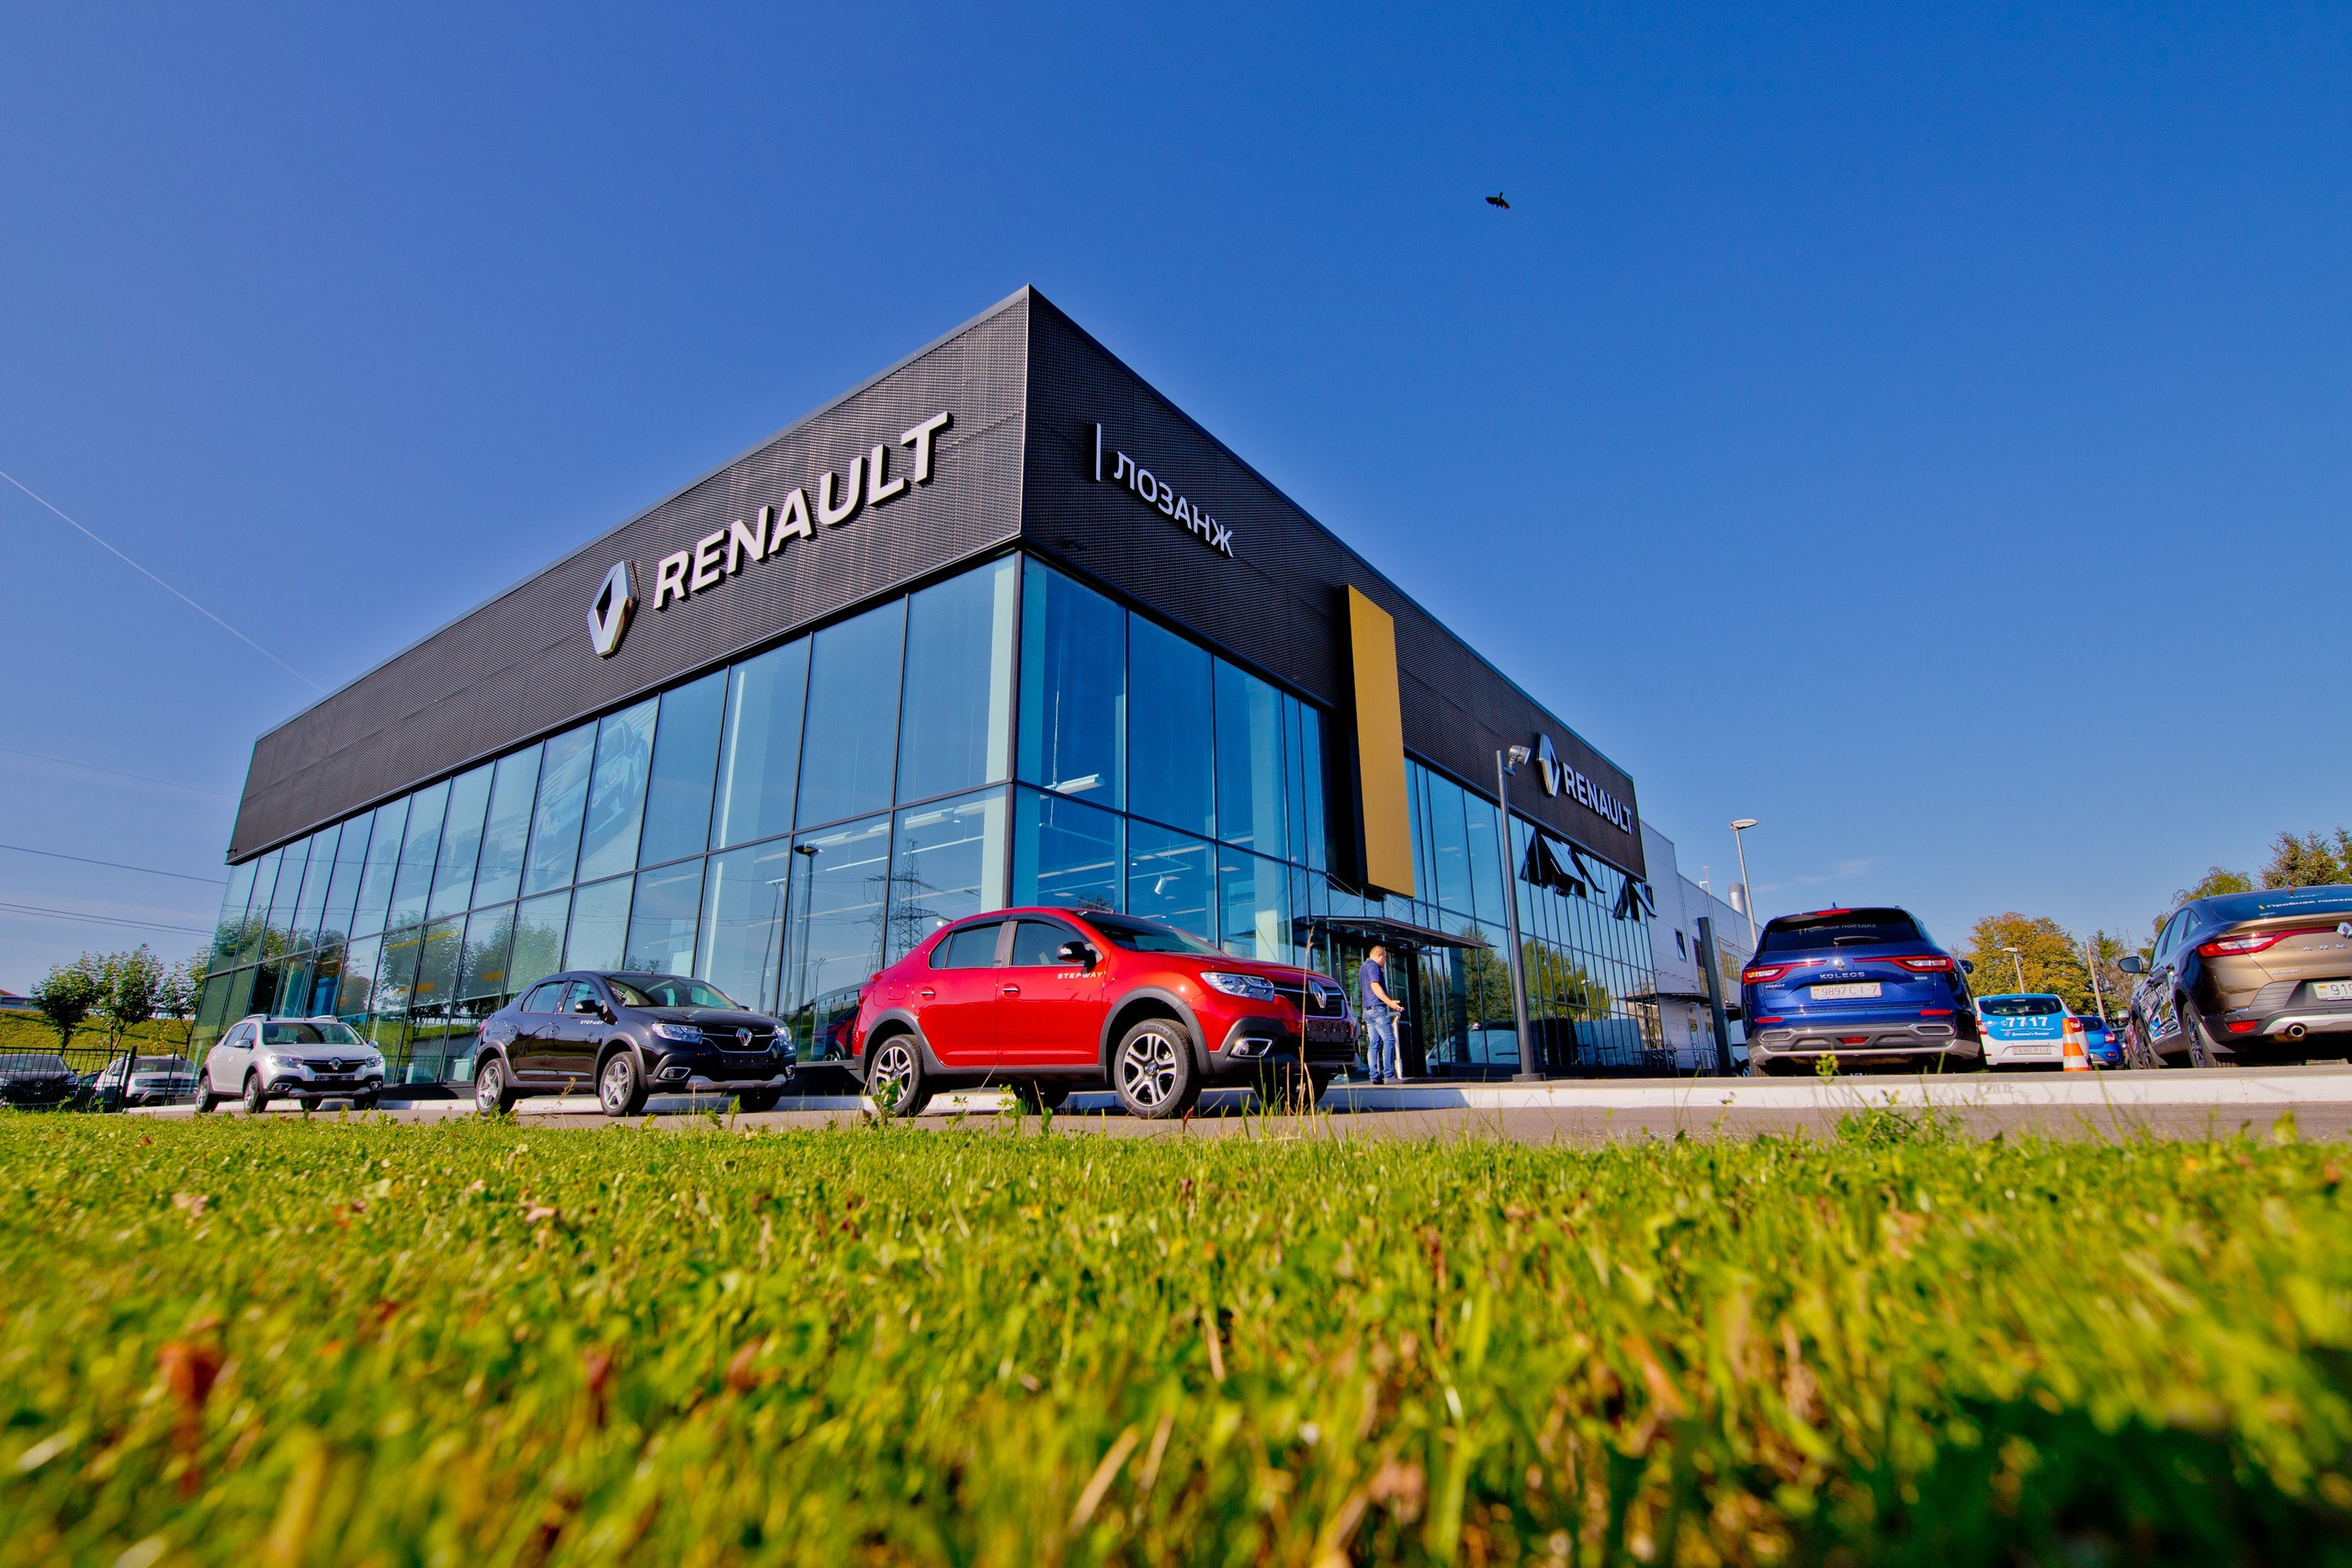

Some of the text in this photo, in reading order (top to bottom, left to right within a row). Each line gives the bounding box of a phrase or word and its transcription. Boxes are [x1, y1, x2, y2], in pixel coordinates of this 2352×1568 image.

[653, 411, 949, 610] RENAULT
[1114, 451, 1234, 558] ЛОЗАНЖ
[1563, 762, 1633, 835] RENAULT
[1057, 971, 1102, 979] STEPWAY
[1819, 971, 1865, 979] KOLEOS
[1821, 986, 1847, 997] 9897
[2006, 1016, 2048, 1028] 7717
